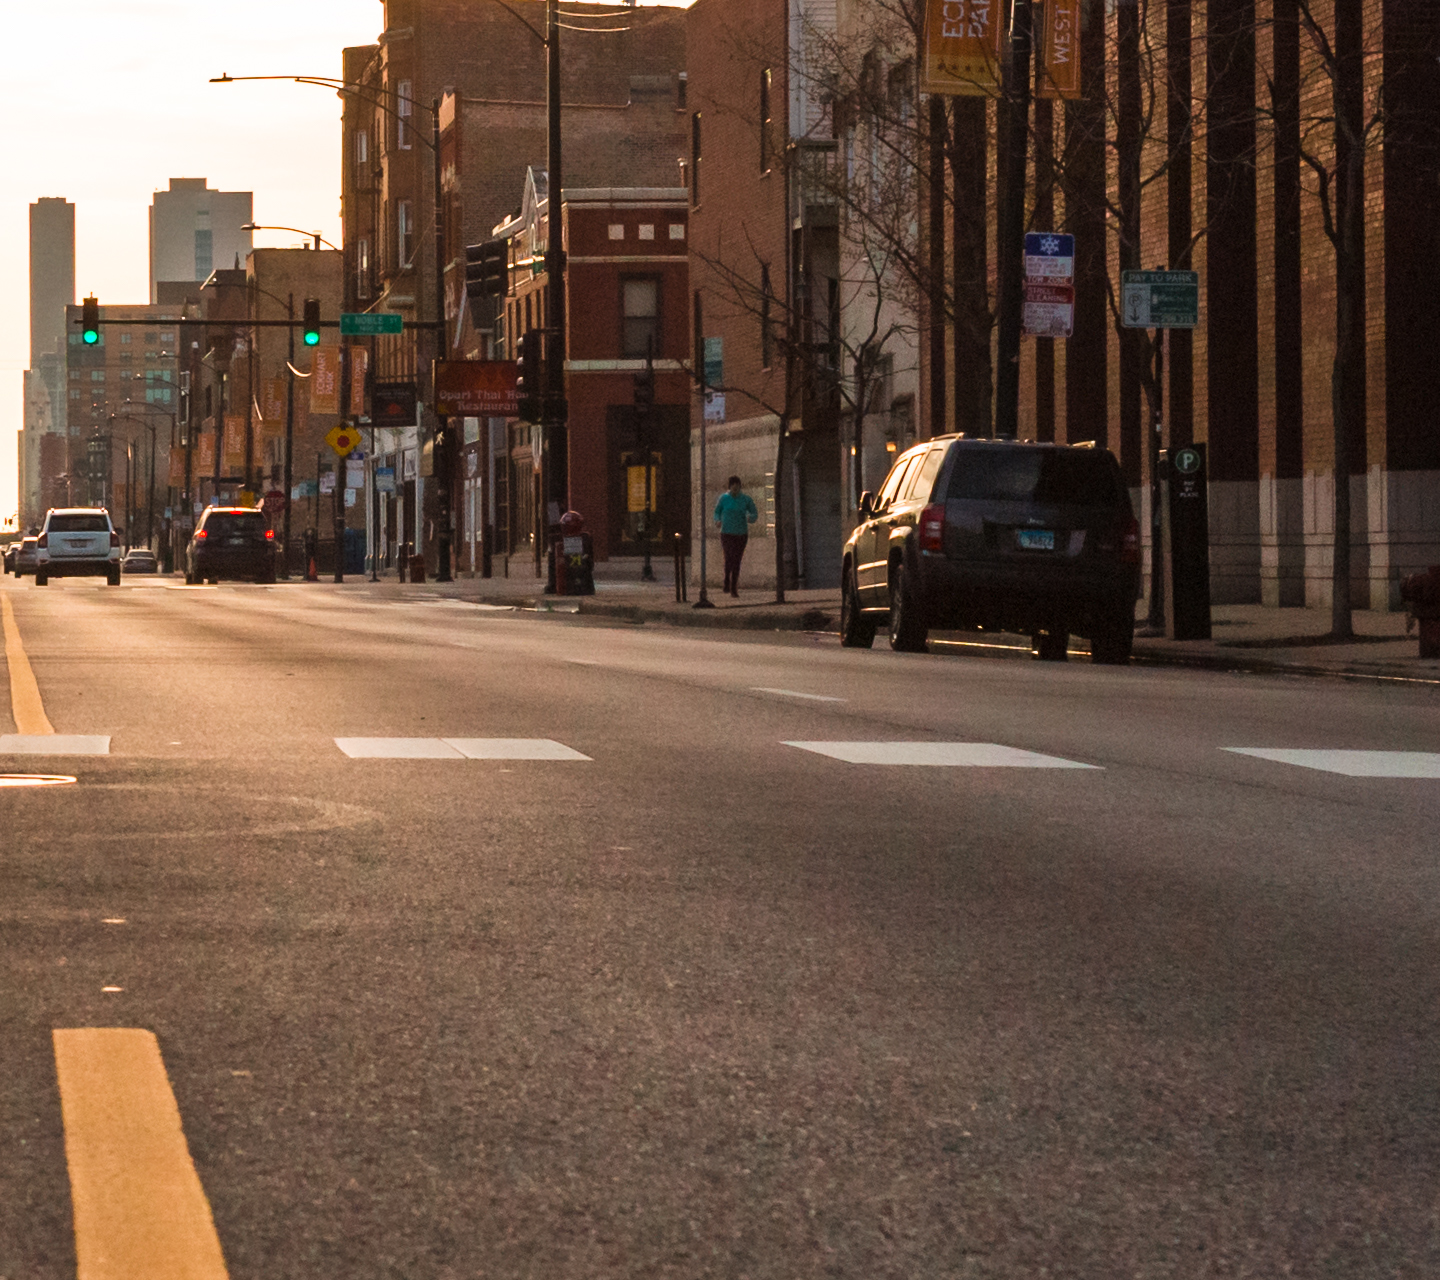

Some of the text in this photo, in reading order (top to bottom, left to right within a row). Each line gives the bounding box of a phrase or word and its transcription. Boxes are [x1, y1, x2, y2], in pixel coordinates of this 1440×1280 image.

[1052, 5, 1071, 65] WEST
[1165, 274, 1192, 282] PARK
[474, 389, 501, 400] Thai
[457, 400, 518, 411] Restauran
